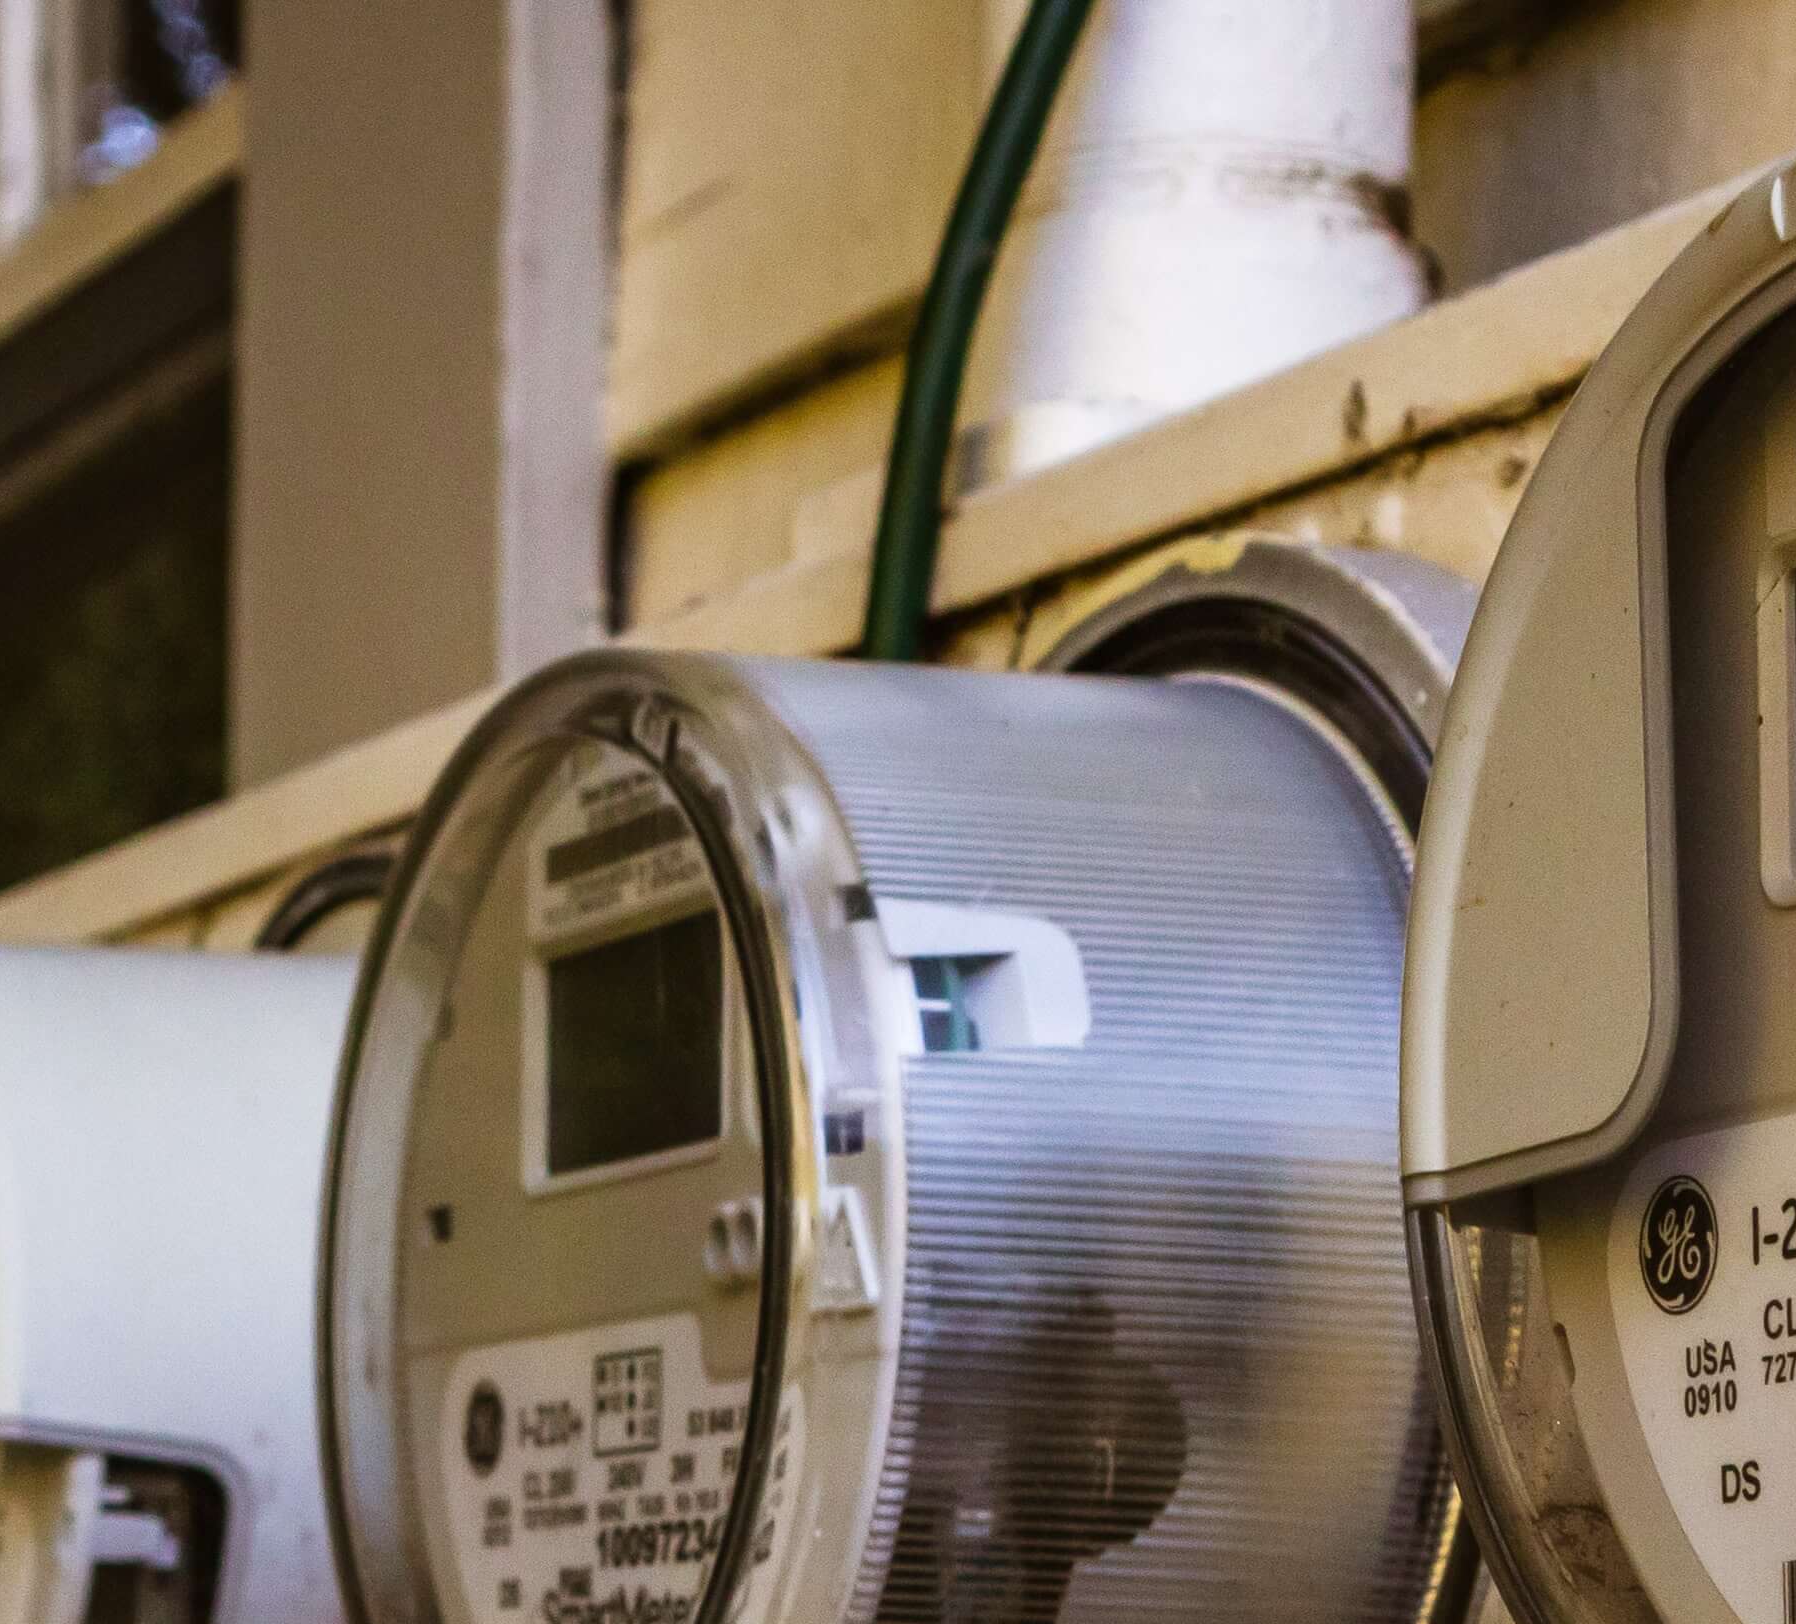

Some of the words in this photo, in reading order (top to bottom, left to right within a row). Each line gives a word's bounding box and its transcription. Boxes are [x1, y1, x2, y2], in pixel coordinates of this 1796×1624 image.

[1685, 1340, 1737, 1379] USA
[1684, 1379, 1738, 1418] 0910
[1720, 1460, 1762, 1504] DS
